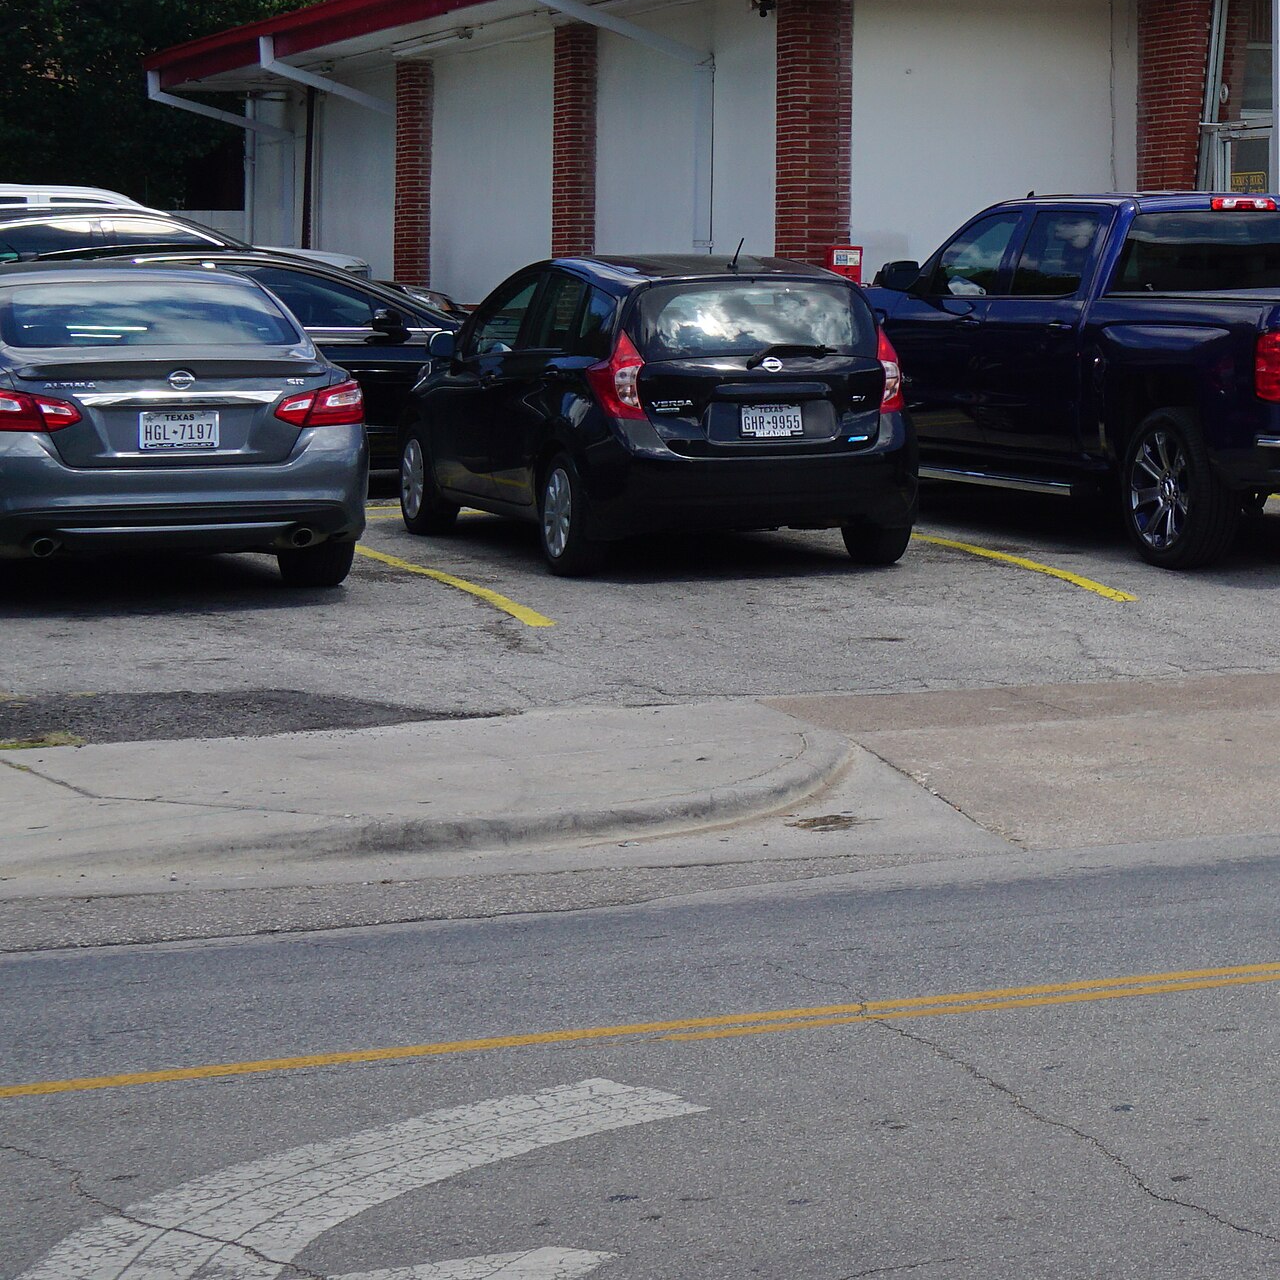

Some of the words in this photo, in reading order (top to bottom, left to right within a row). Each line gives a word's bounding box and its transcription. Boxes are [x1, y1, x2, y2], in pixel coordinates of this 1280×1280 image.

[43, 381, 97, 389] ALTIMA
[651, 399, 694, 408] VERSA
[165, 413, 195, 422] TEXAS
